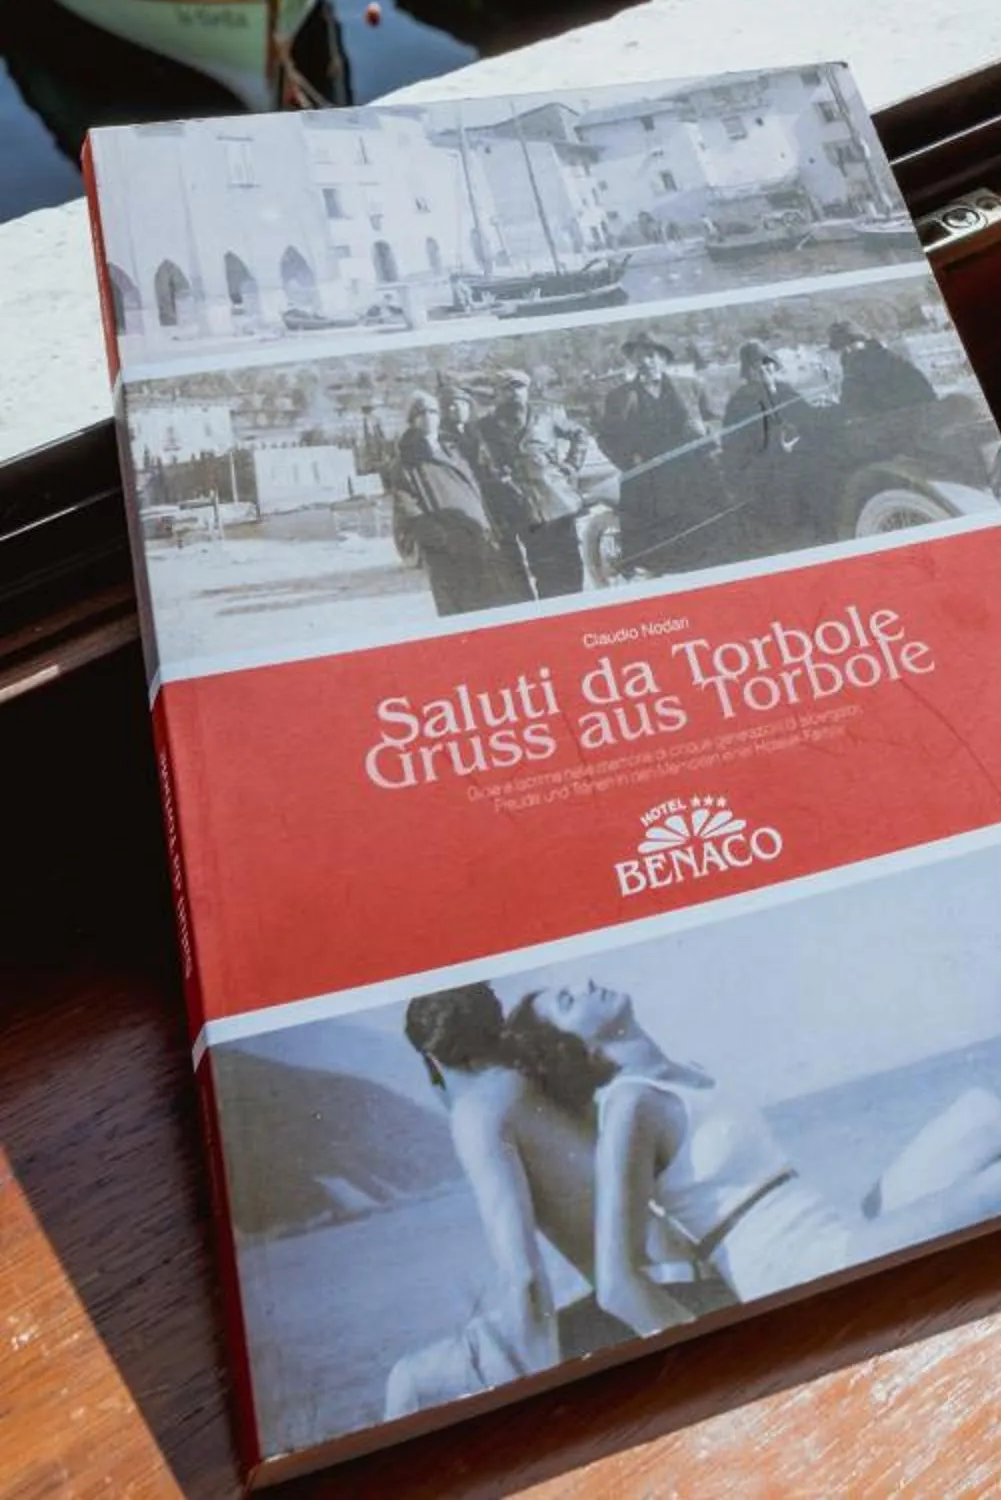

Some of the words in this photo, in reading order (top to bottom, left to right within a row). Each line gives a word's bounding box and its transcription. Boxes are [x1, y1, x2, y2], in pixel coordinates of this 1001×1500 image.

[583, 630, 639, 649] Claudio
[376, 667, 561, 746] Saluti
[580, 656, 661, 706] da
[671, 605, 905, 686] Torbole
[364, 722, 558, 790] Gruss
[577, 695, 689, 750] aus
[700, 640, 936, 719] Torbole
[640, 797, 687, 827] HOTEL
[614, 827, 783, 897] BENACO
